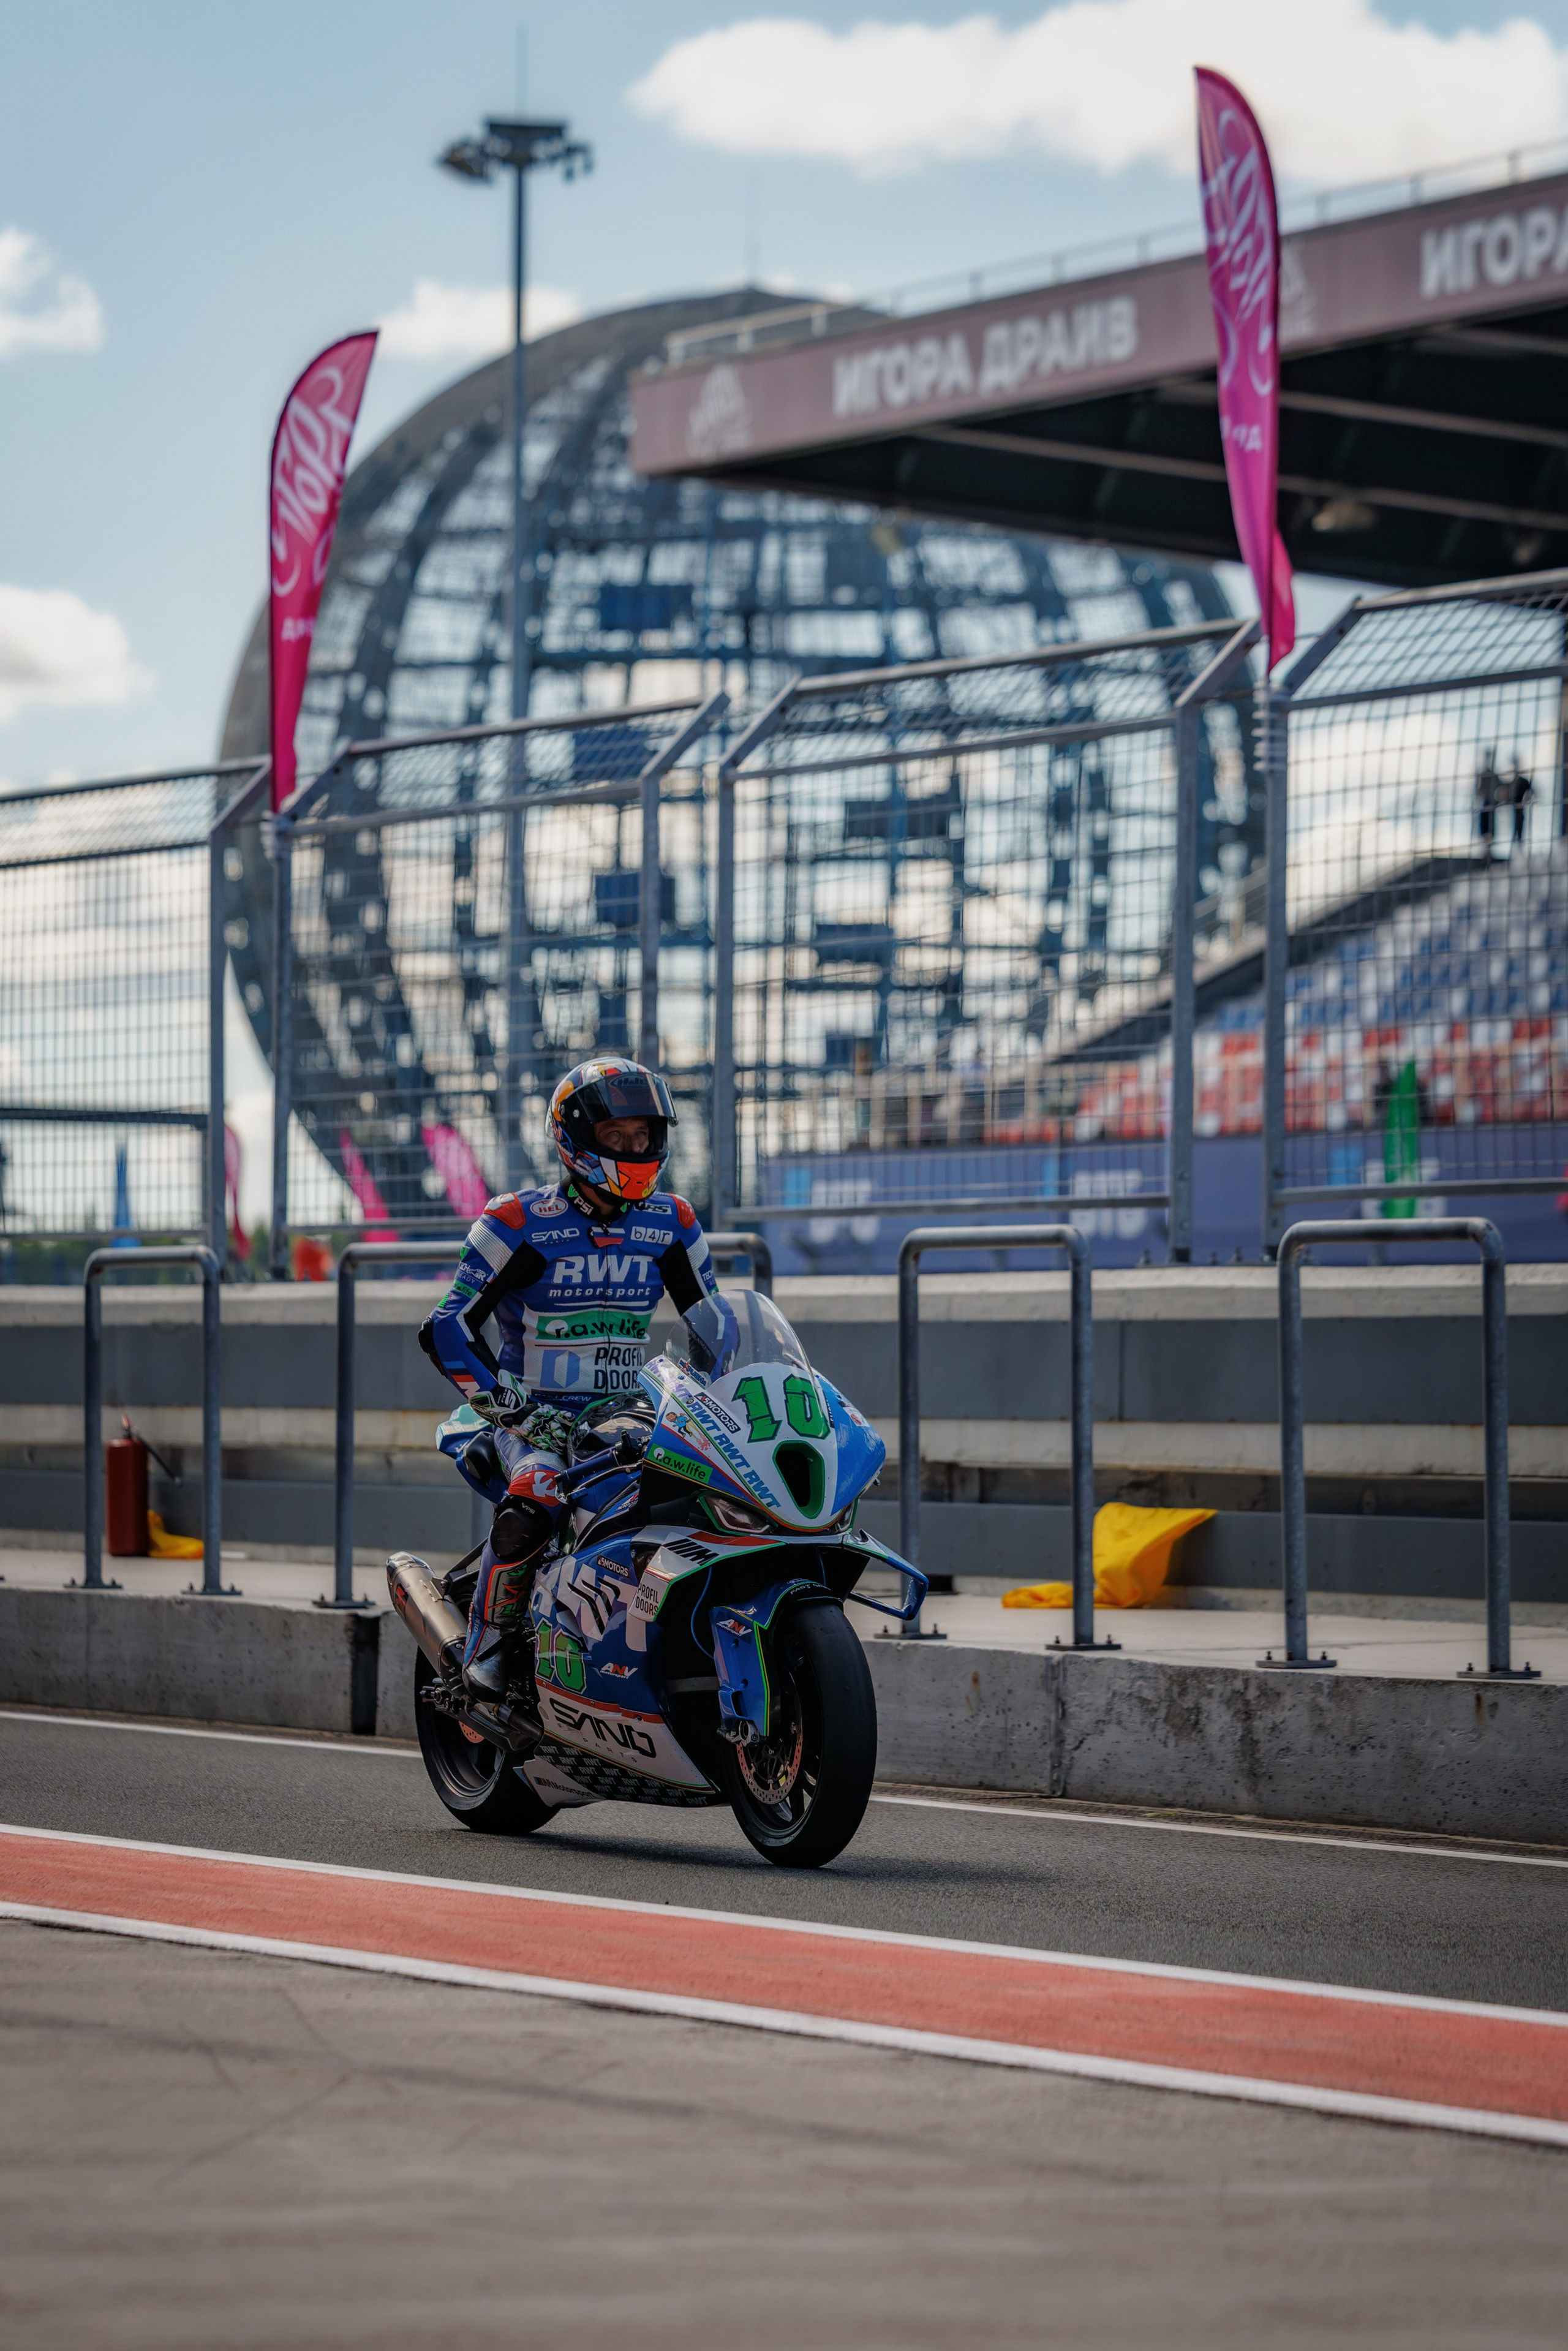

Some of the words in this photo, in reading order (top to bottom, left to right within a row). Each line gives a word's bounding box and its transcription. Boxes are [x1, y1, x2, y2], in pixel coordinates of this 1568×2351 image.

[833, 331, 976, 418] ИГОРА
[552, 1255, 654, 1284] RWT
[548, 1287, 651, 1298] motorsport
[594, 1347, 642, 1367] PROFIL
[731, 1374, 831, 1444] 10
[655, 1452, 706, 1480] r.a.w.life
[687, 1401, 722, 1432] RWT
[714, 1433, 750, 1468] RWT
[743, 1470, 782, 1508] RWT
[638, 1583, 658, 1604] PROFIL
[635, 1596, 658, 1616] DOORS
[600, 1662, 638, 1677] ANV
[600, 1670, 630, 1680] motorsport
[549, 1697, 657, 1758] SAND
